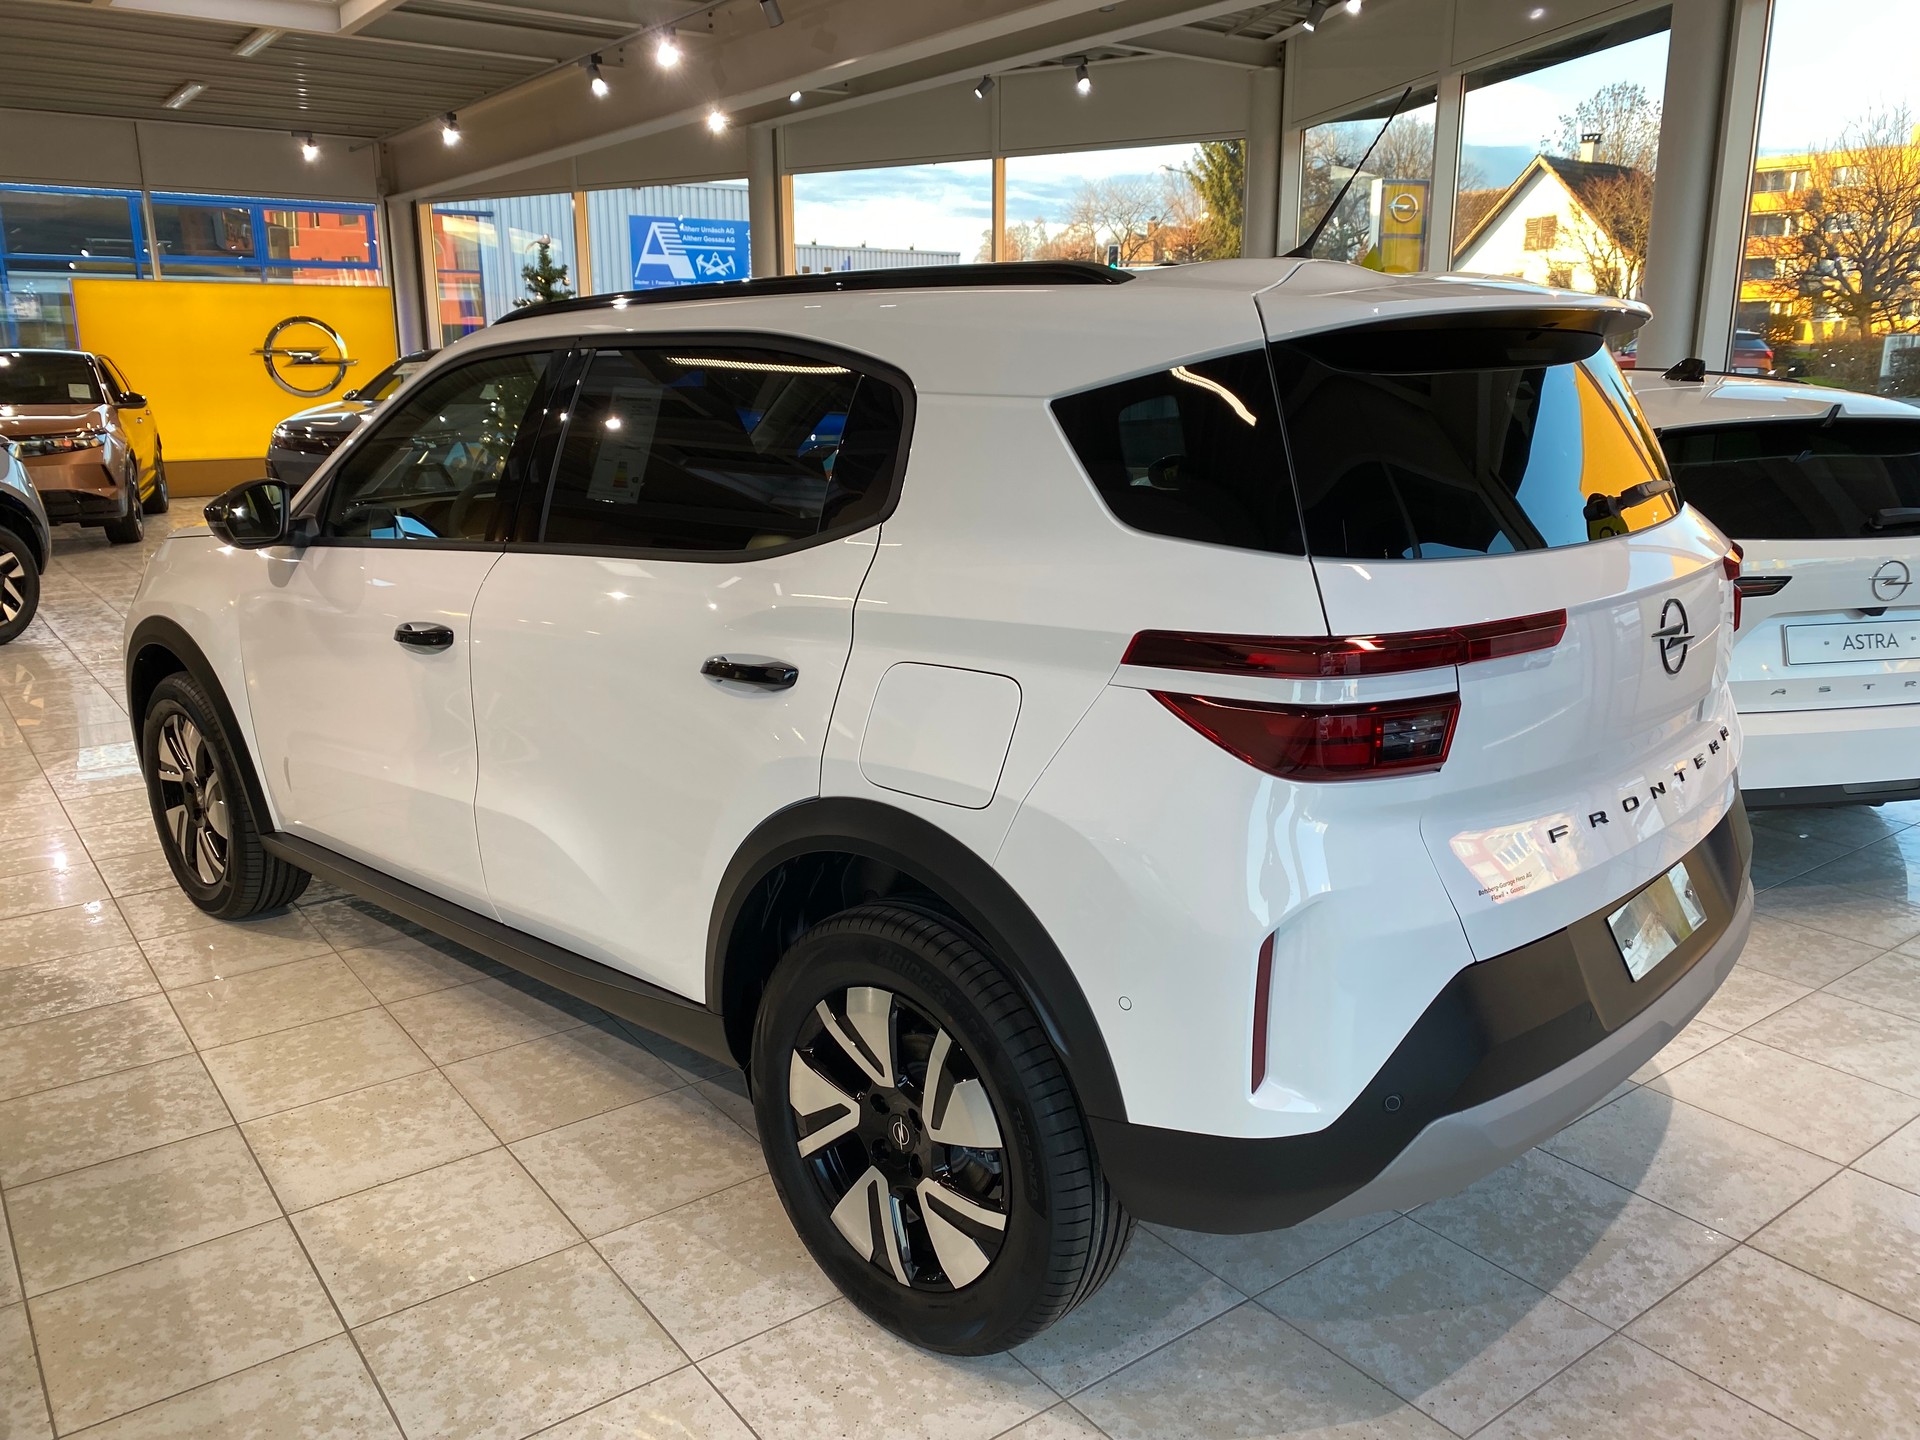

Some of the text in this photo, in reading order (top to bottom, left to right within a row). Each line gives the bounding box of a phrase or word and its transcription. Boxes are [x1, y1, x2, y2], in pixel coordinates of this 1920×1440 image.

[682, 234, 736, 244] Altherr Gossau AG
[726, 227, 735, 235] AG
[1842, 633, 1900, 650] ASTRA
[1548, 725, 1730, 844] FRONTERA
[1491, 885, 1525, 901] Flawil Gossau
